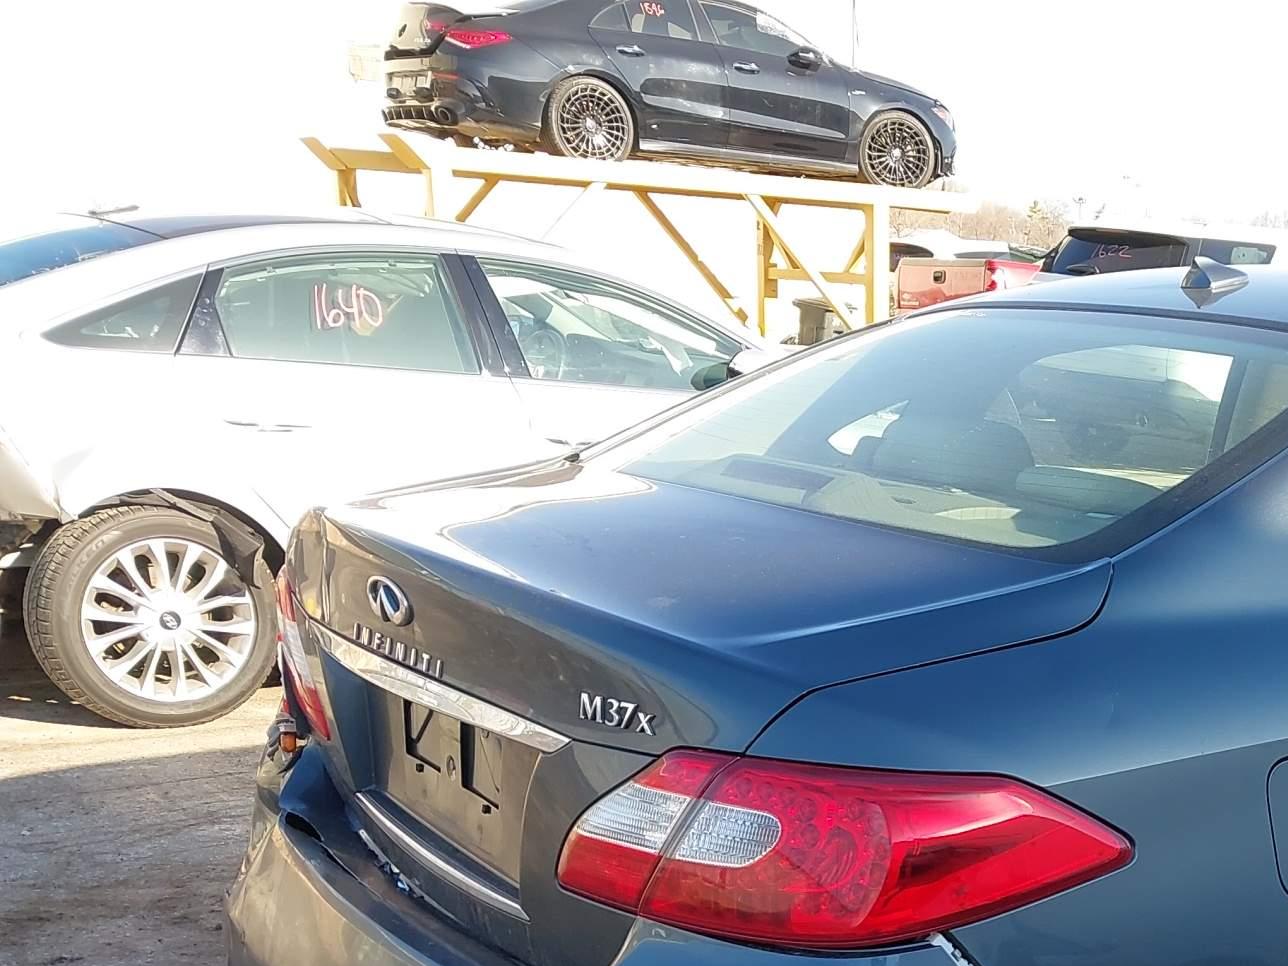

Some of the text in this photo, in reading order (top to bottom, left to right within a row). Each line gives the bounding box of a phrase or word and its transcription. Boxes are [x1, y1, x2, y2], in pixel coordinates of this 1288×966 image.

[1091, 244, 1133, 259] 1622
[313, 283, 383, 329] 1640
[353, 622, 443, 679] INFINITI
